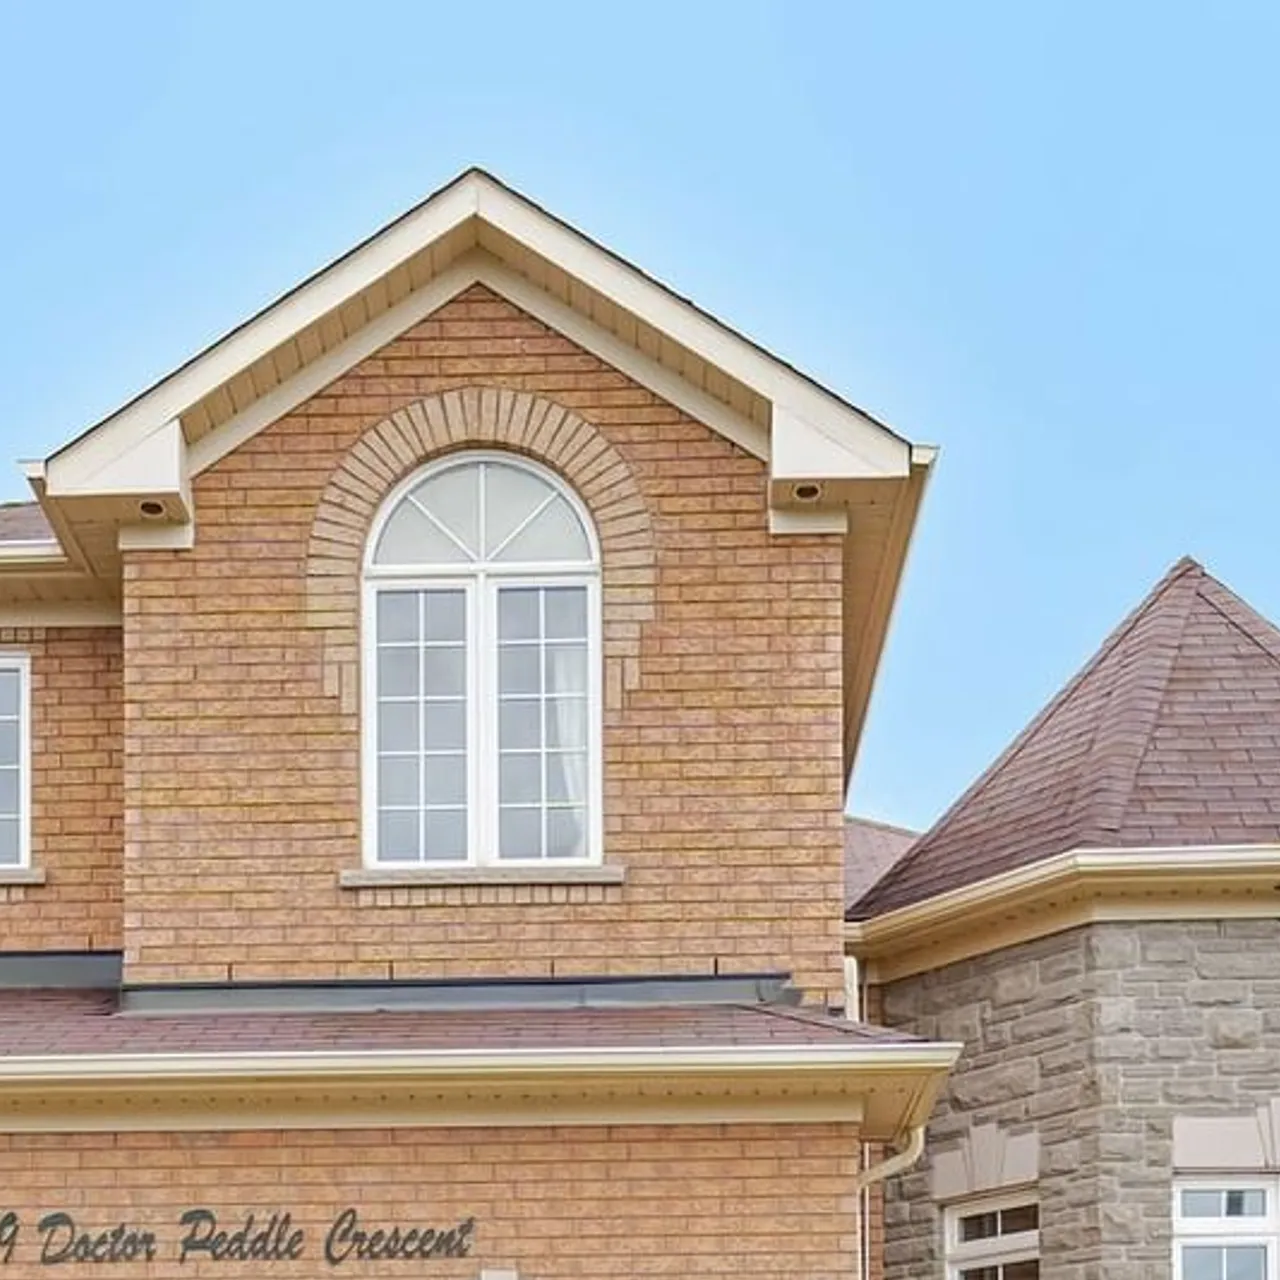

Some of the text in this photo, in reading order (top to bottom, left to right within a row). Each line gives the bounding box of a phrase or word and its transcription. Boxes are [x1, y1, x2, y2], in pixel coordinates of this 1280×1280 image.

[37, 1211, 157, 1266] Doctor
[179, 1208, 305, 1264] Peddle
[323, 1207, 475, 1266] Crescent
